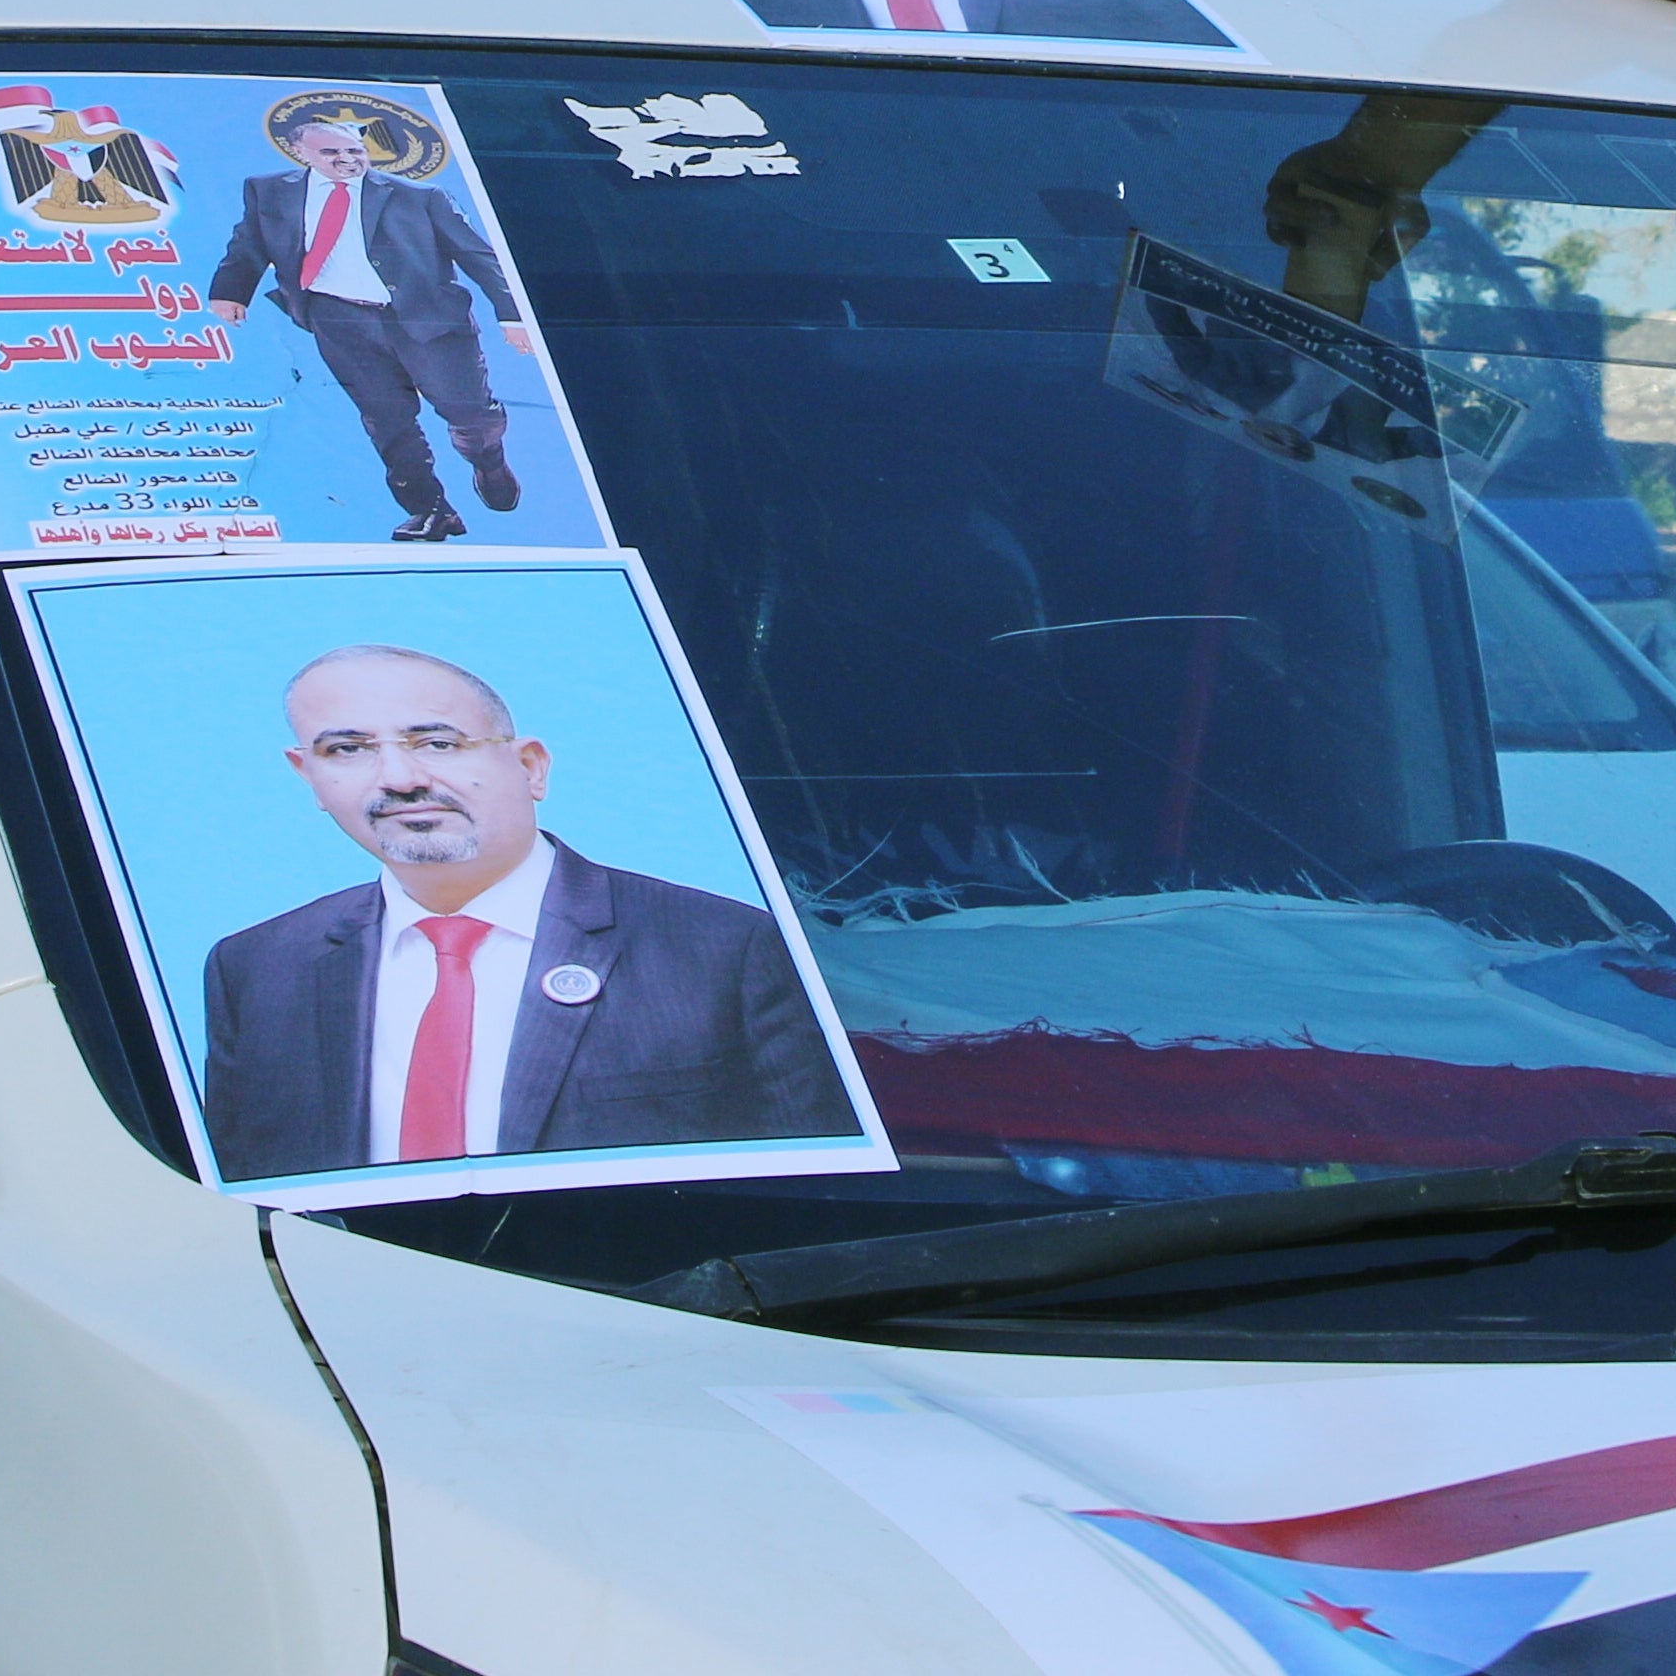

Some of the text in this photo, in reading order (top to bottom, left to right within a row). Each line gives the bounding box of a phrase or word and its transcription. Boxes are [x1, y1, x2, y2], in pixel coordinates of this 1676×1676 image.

[106, 229, 179, 276] نعم
[973, 252, 1010, 278] 3
[90, 325, 232, 369] الجنوب
[27, 399, 81, 414] الضالع
[165, 397, 220, 411] المحلية
[14, 423, 71, 438] مقبل
[77, 422, 118, 439] علي
[142, 420, 199, 436] الركن
[205, 421, 253, 435] اللواء
[29, 445, 256, 466] محافظ محافظة الضالع
[63, 471, 237, 491] قائد محور الضالع
[52, 492, 259, 516] قائد اللواء 33 مدرع
[36, 520, 101, 545] وأهلها
[105, 523, 166, 543] رجالها
[172, 521, 208, 542] بكل
